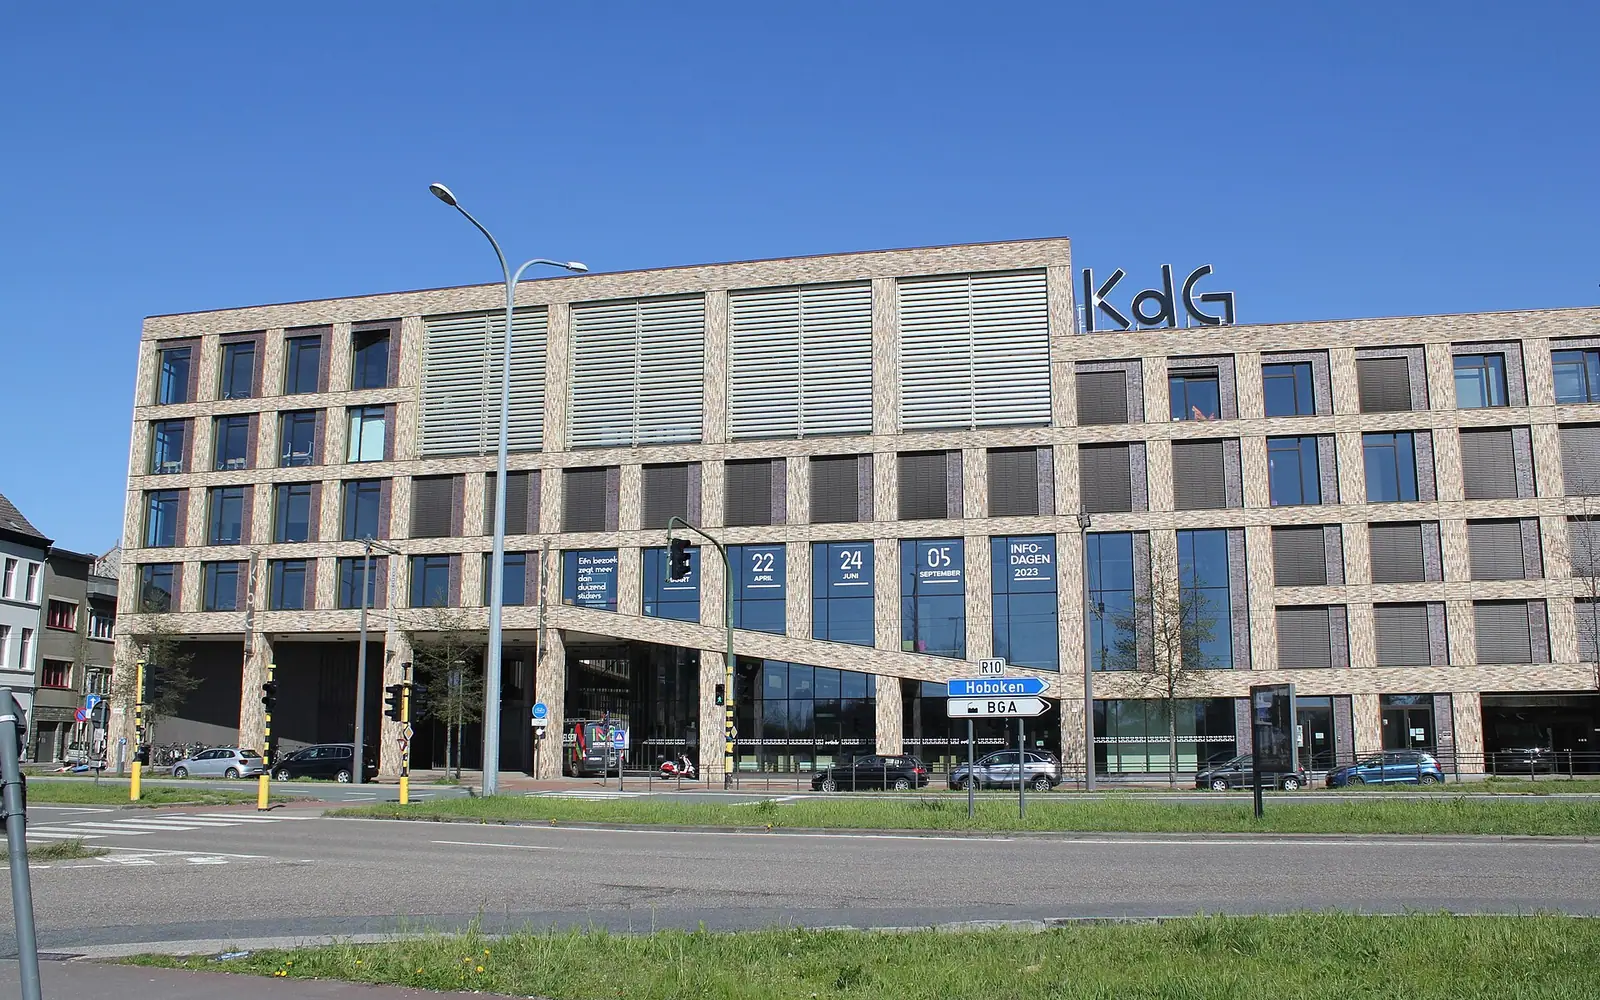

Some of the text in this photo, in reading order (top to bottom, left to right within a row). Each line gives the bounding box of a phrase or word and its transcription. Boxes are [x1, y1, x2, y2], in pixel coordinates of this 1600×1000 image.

[1082, 263, 1236, 332] KdG
[1010, 543, 1043, 554] INFO-
[592, 556, 618, 565] bezoek
[752, 553, 774, 572] 22
[840, 550, 863, 570] 24
[927, 547, 951, 568] 05
[1010, 554, 1051, 565] DAGEN
[842, 572, 859, 580] JUNI
[919, 569, 961, 578] SEPTEMBER
[1014, 567, 1039, 577] 2023
[577, 574, 593, 582] dan
[981, 661, 1001, 673] R10
[966, 681, 1024, 694] Hoboken
[987, 701, 1018, 714] BGA
